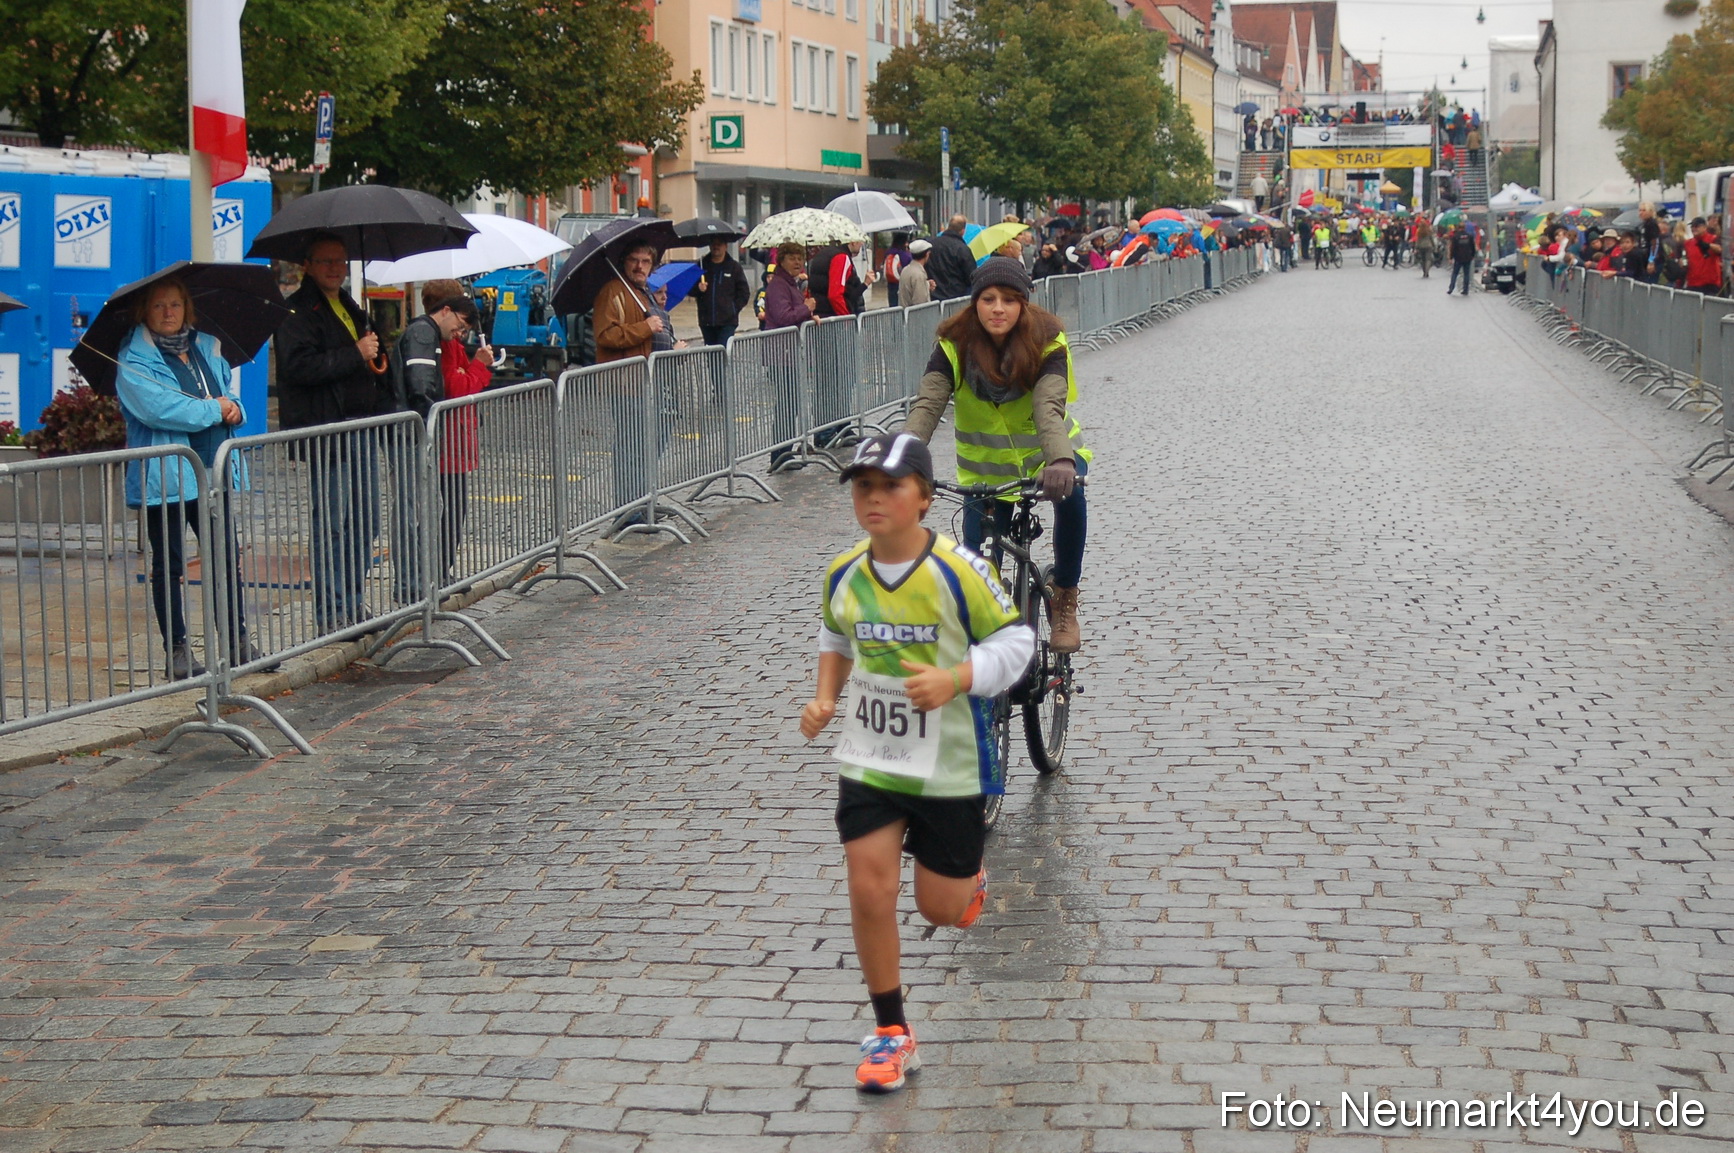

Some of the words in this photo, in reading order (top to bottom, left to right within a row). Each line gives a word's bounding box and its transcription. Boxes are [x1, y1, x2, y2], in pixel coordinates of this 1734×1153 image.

[320, 102, 331, 134] P
[715, 119, 739, 145] D
[1336, 152, 1384, 165] START
[952, 544, 1011, 614] BOCK
[854, 621, 940, 643] BOCK
[874, 684, 907, 697] Neuma
[855, 695, 927, 738] 4051
[840, 738, 876, 759] David
